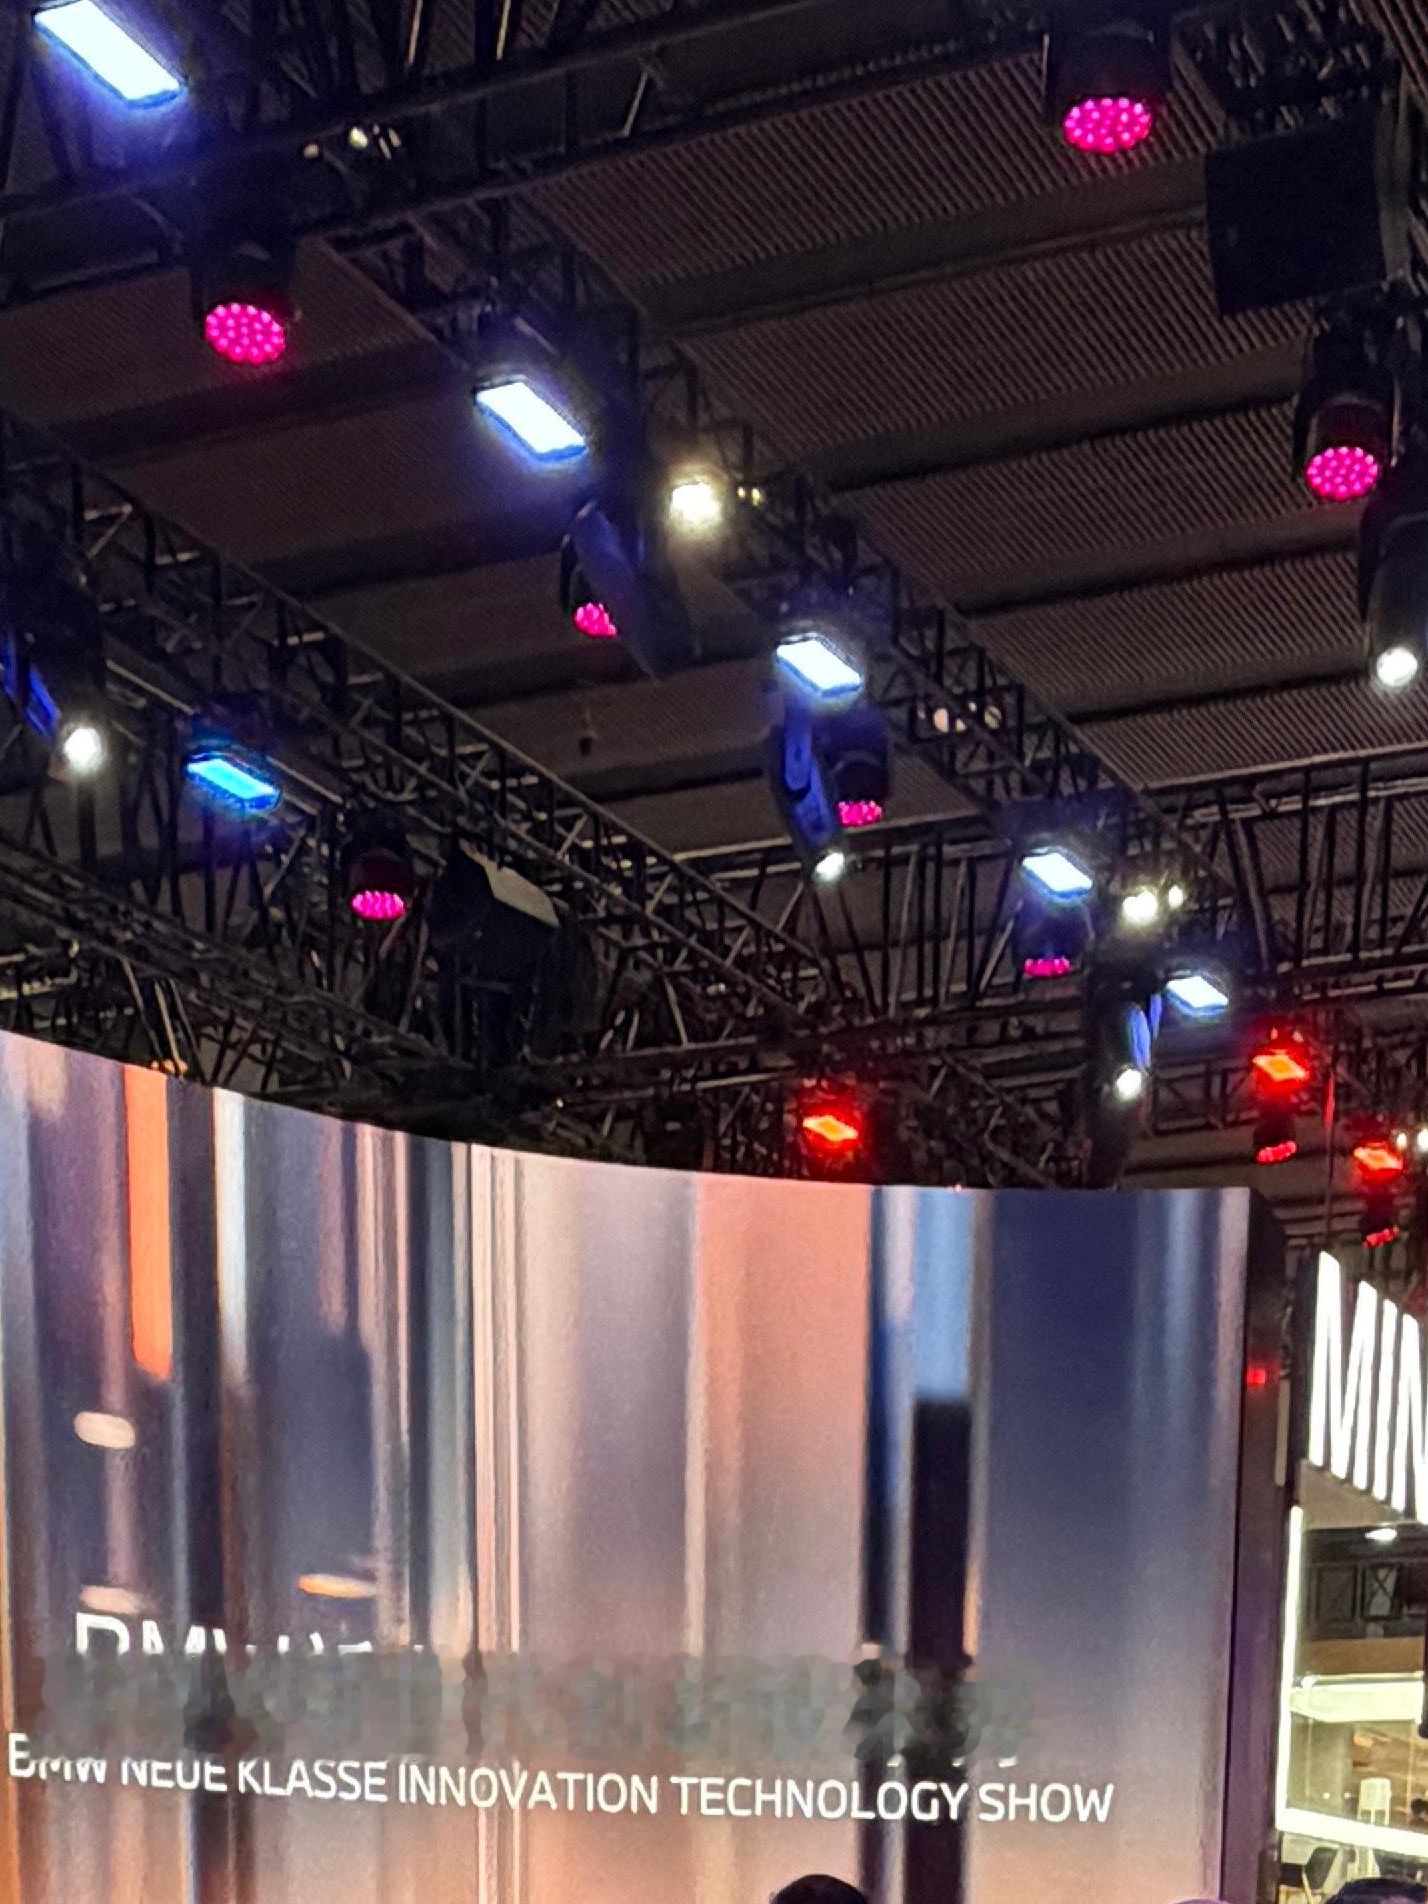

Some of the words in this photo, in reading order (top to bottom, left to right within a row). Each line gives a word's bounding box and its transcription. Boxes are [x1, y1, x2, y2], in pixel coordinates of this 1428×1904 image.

[121, 1756, 228, 1792] NEUE
[238, 1757, 388, 1803] KLASSE
[398, 1760, 658, 1815] INNOVATION
[670, 1773, 969, 1824] TECHNOLOGY
[977, 1781, 1115, 1824] SHOW
